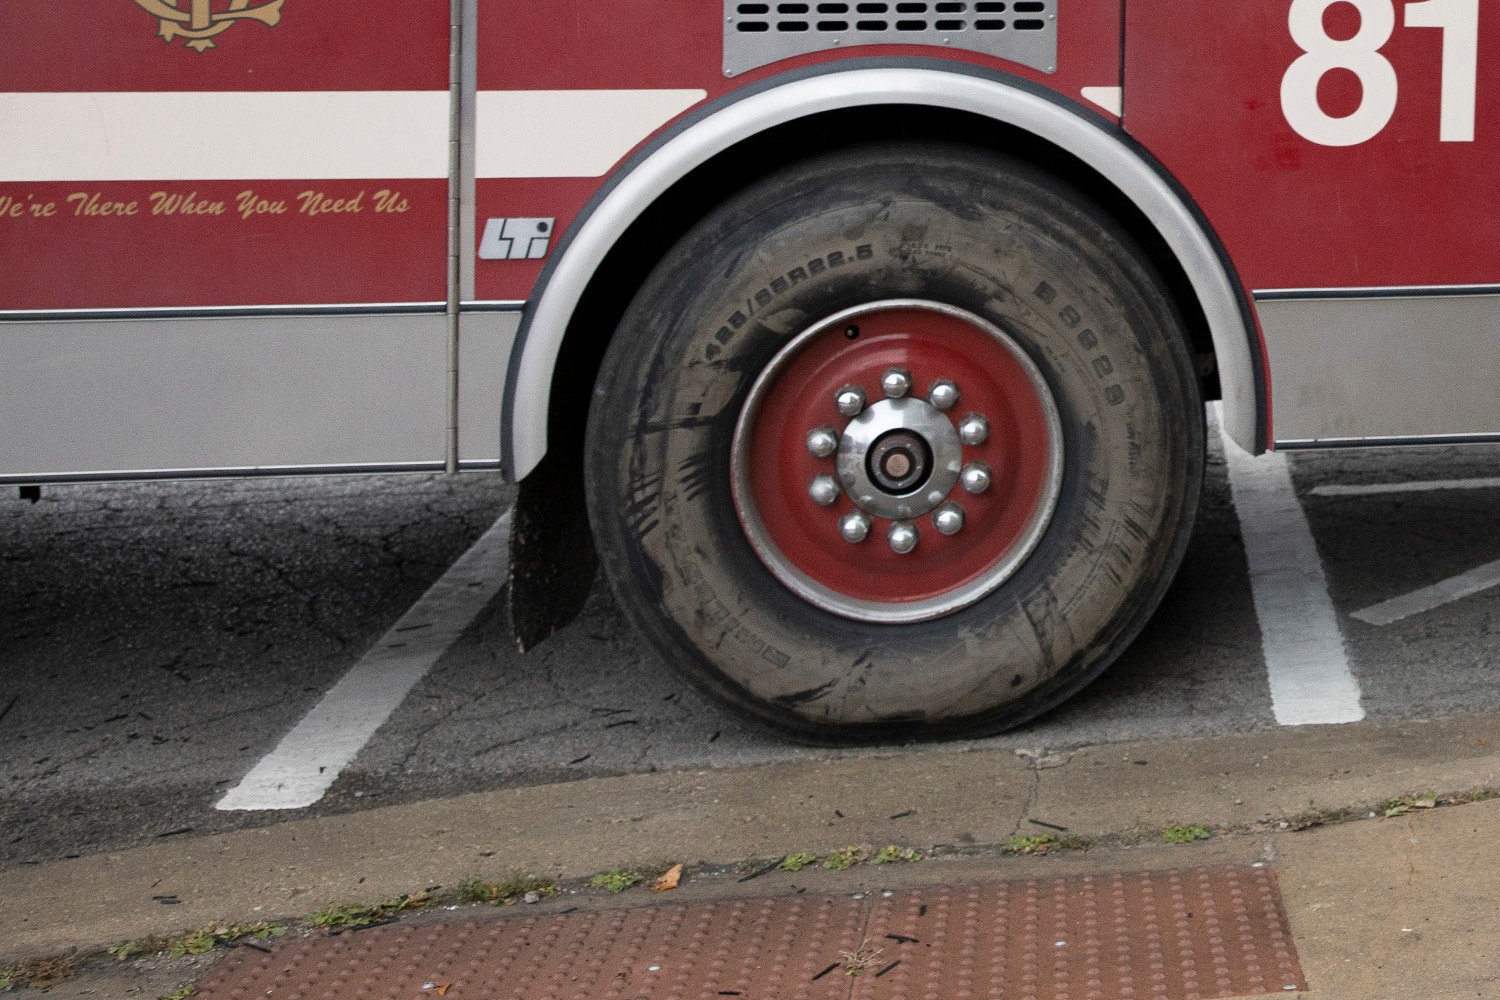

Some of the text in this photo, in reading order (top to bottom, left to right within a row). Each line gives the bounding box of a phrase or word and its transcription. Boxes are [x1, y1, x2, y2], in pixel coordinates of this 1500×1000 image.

[66, 191, 140, 217] There
[149, 190, 226, 216] When
[235, 189, 287, 220] You
[296, 190, 366, 216] Need
[372, 189, 410, 214] Us
